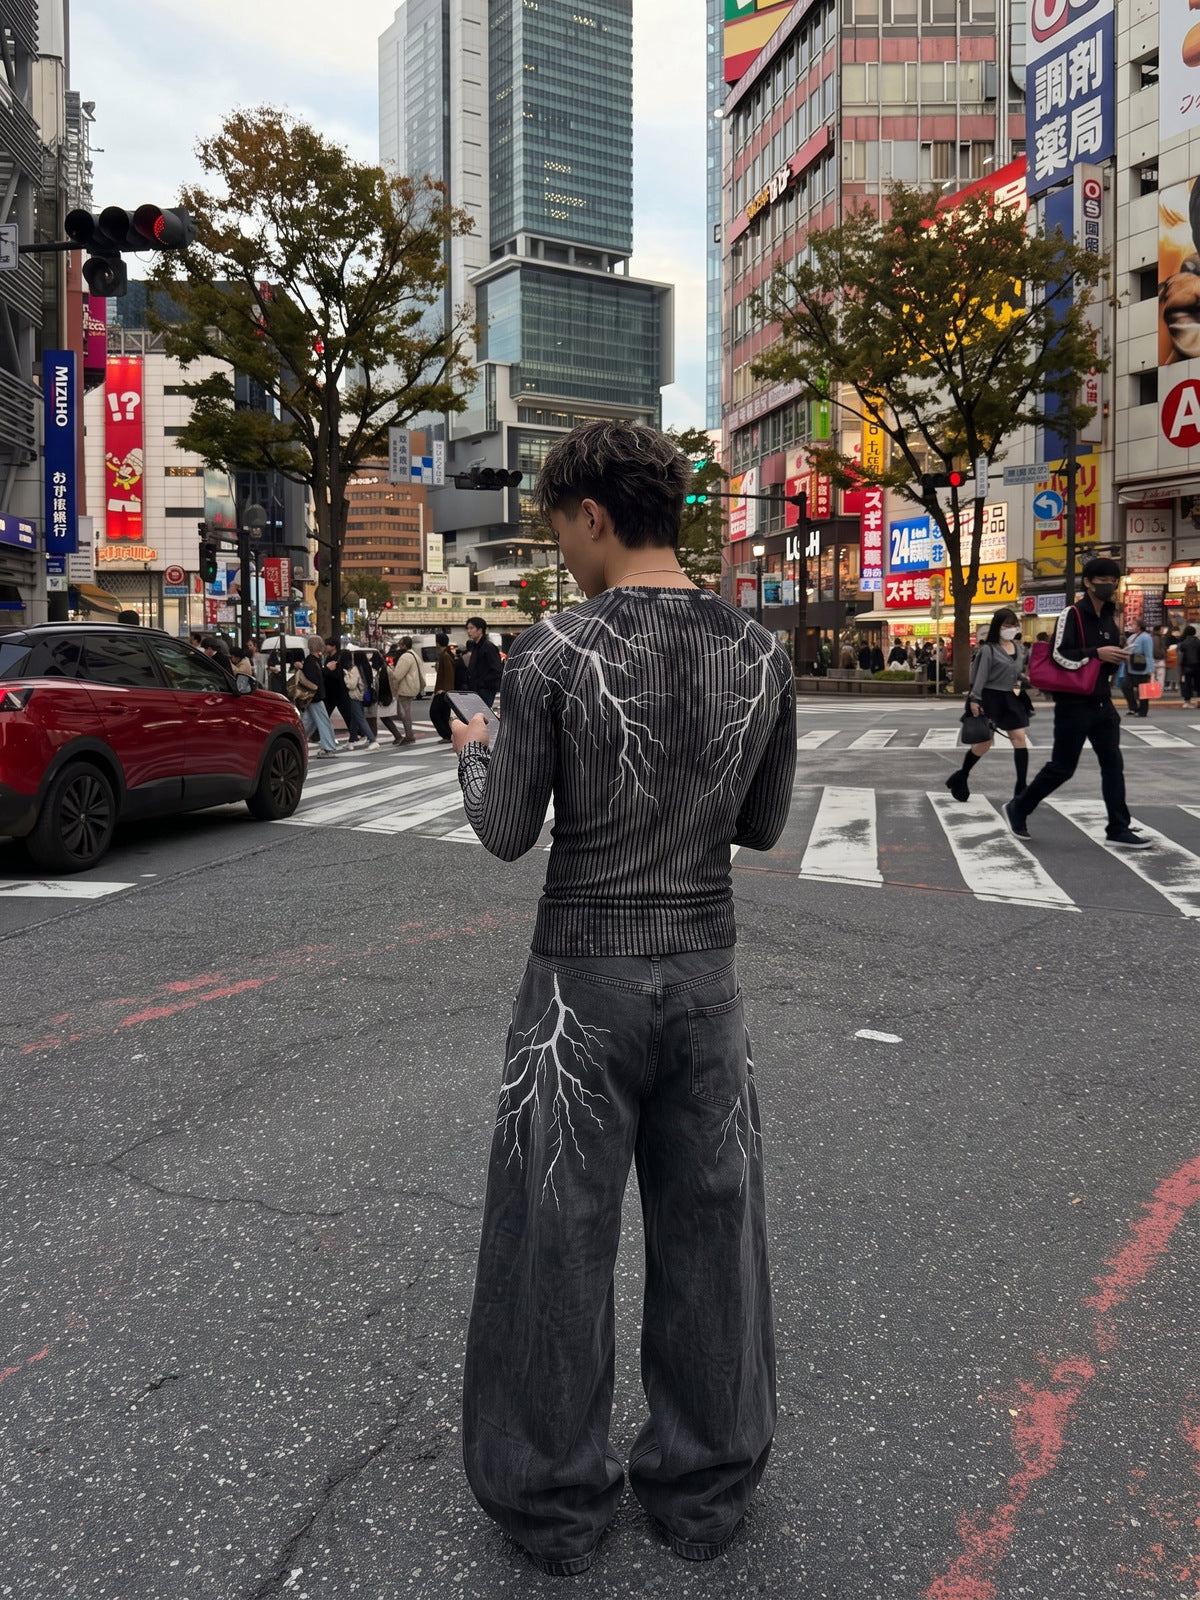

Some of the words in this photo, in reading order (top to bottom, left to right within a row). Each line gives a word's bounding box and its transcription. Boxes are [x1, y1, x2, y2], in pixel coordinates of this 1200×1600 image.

[1035, 29, 1103, 122] 調剤
[1035, 95, 1103, 182] 薬局
[55, 365, 68, 427] MIZUHO
[891, 526, 910, 566] 24
